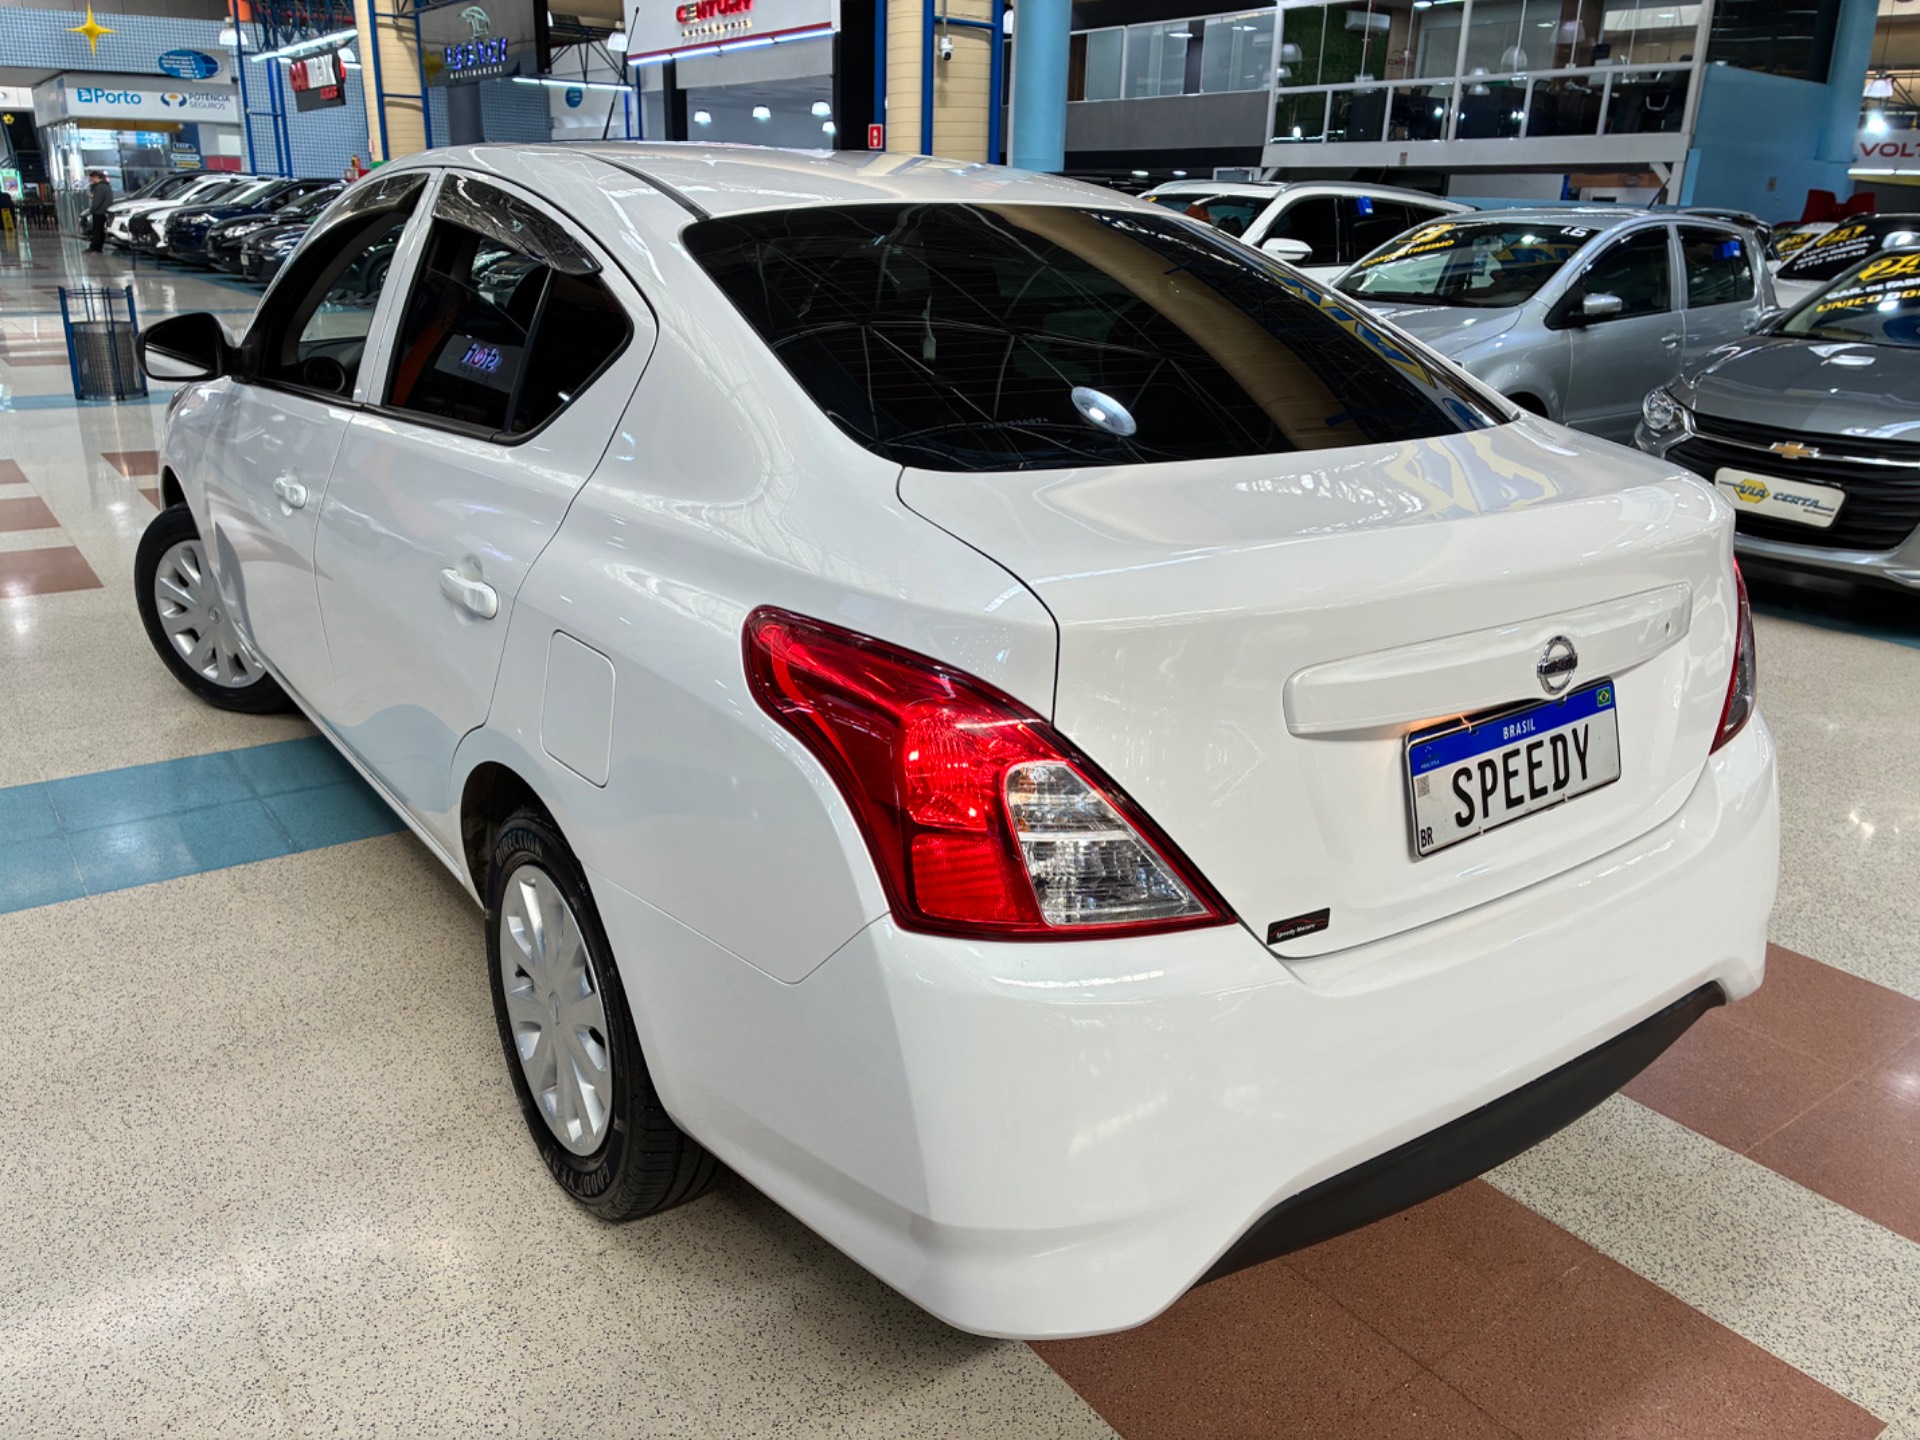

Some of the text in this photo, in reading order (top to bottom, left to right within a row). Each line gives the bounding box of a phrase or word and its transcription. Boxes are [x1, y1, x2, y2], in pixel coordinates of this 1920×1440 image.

[94, 89, 142, 105] Porto
[1739, 484, 1820, 508] VIA CERTA
[1502, 718, 1537, 740] BRASIL
[1452, 723, 1590, 828] SPEEDY
[1420, 826, 1434, 848] BR
